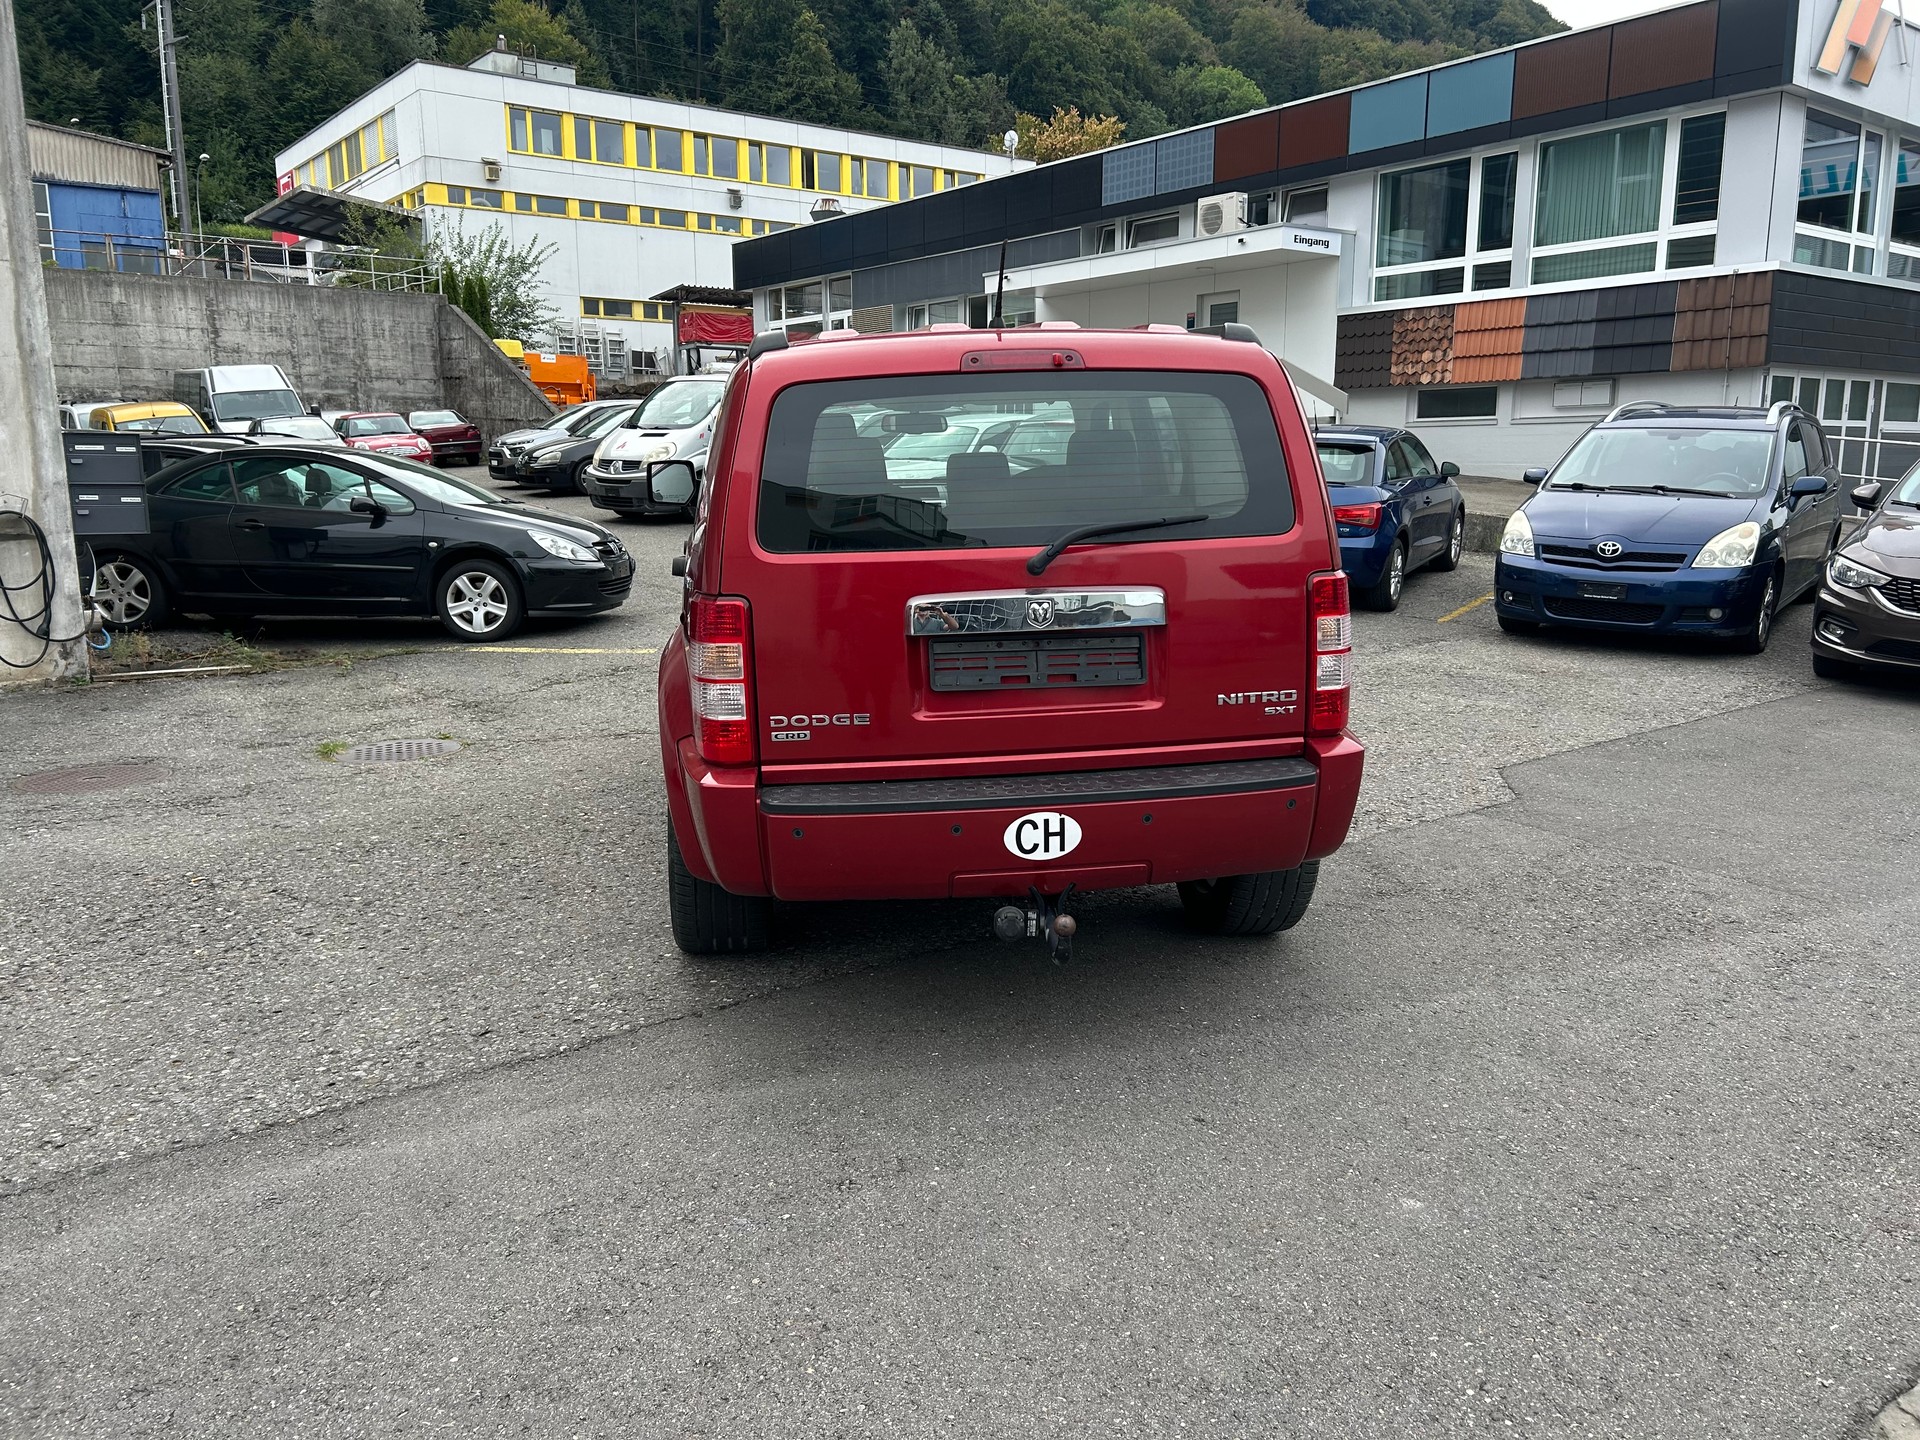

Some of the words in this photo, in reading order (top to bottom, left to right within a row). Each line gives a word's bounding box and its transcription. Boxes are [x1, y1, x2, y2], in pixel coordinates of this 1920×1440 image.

[1293, 234, 1330, 249] Eingang
[1217, 689, 1298, 706] NITRO
[1264, 705, 1297, 716] SXT
[769, 713, 871, 728] DODGE
[774, 732, 808, 740] CRD
[1015, 817, 1066, 855] CH
